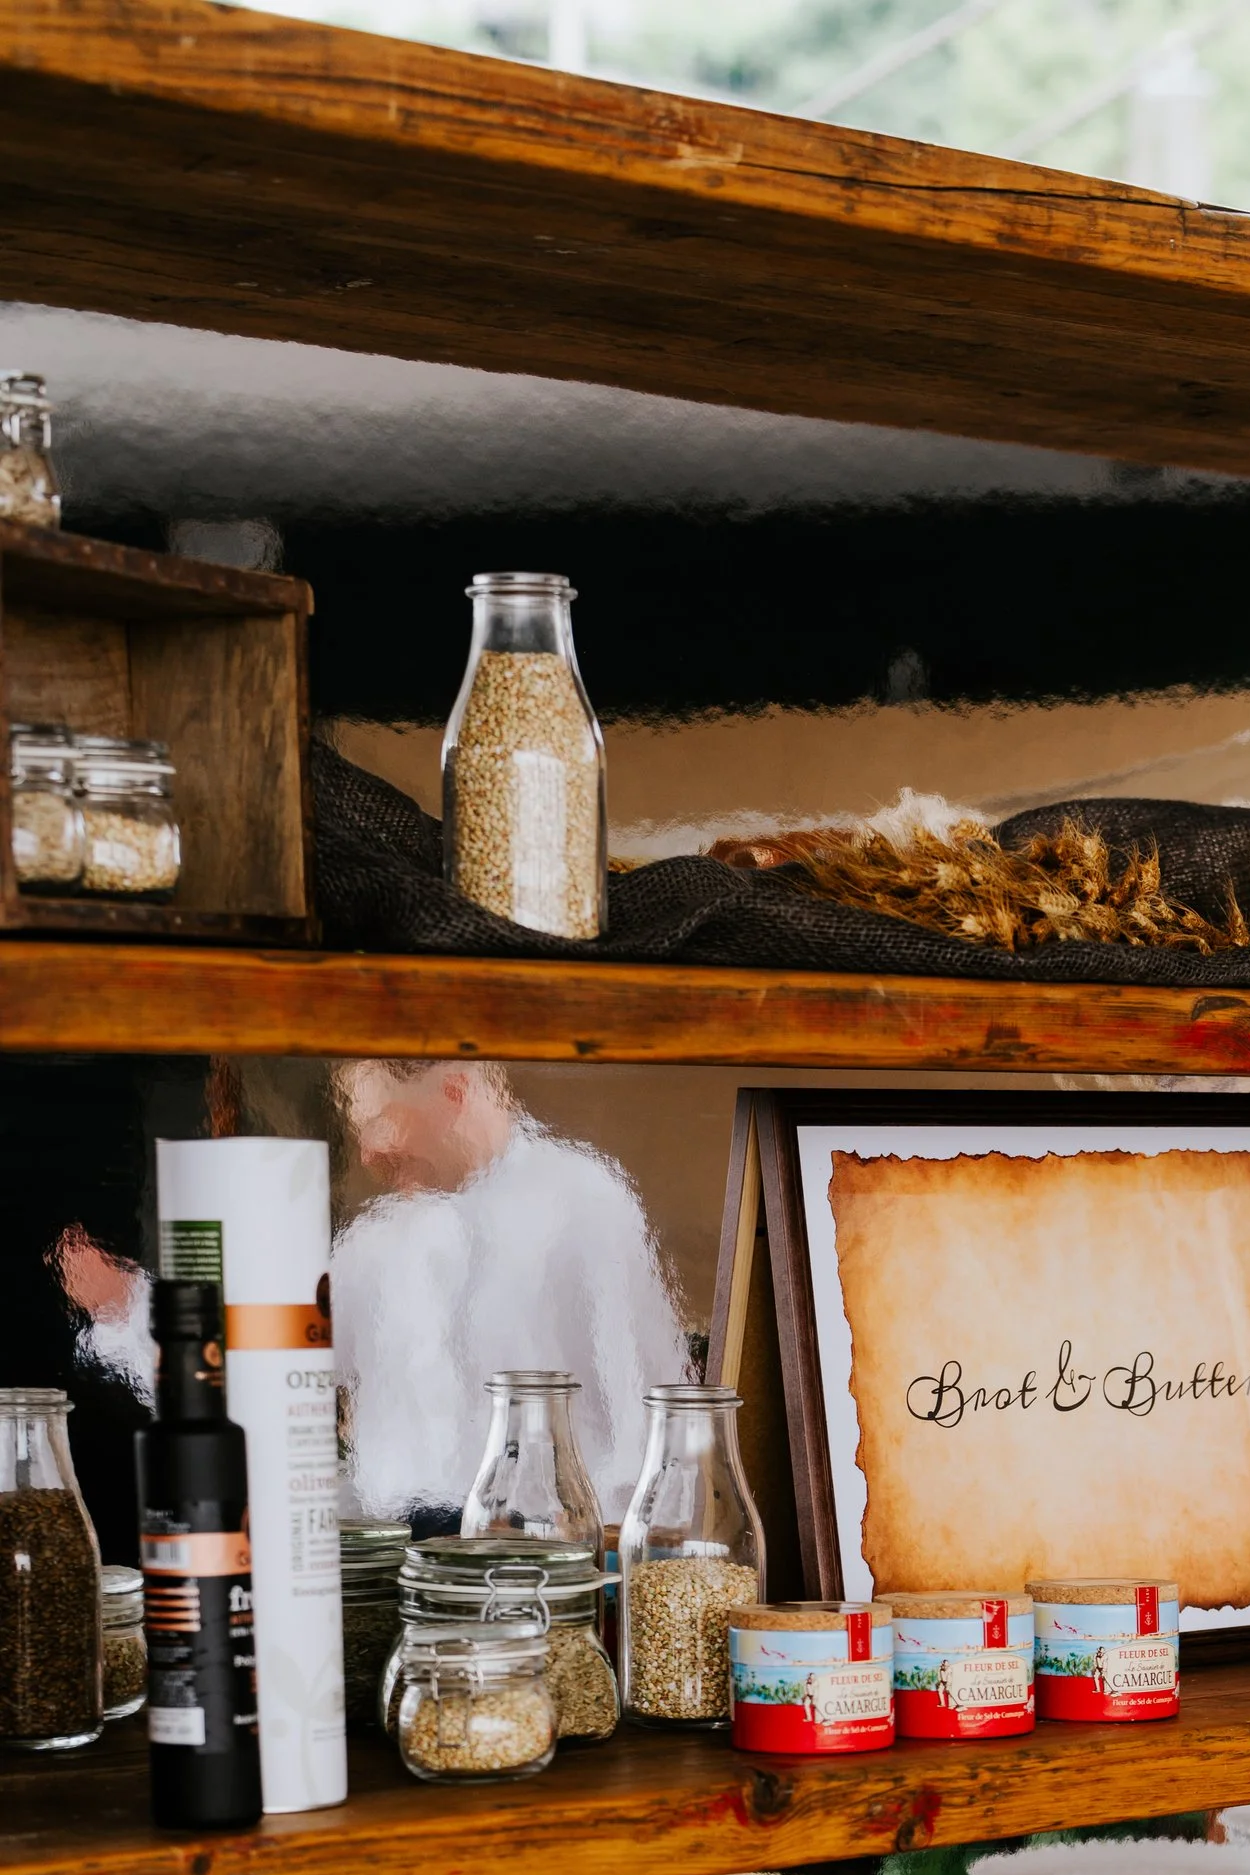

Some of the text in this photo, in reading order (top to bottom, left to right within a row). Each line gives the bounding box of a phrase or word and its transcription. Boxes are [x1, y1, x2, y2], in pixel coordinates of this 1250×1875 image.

[906, 1360, 1037, 1428] Brot
[1045, 1340, 1096, 1412] &
[1119, 1648, 1169, 1659] FLEUR DE SEL
[964, 1660, 1019, 1672] FLEUR DE SEL
[831, 1673, 883, 1685] FLEUR DE SEL
[1112, 1671, 1172, 1688] CAMARGUE
[957, 1684, 1023, 1702] CAMARGUE
[824, 1697, 887, 1715] CAMARGUE
[957, 1712, 974, 1721] Fleur
